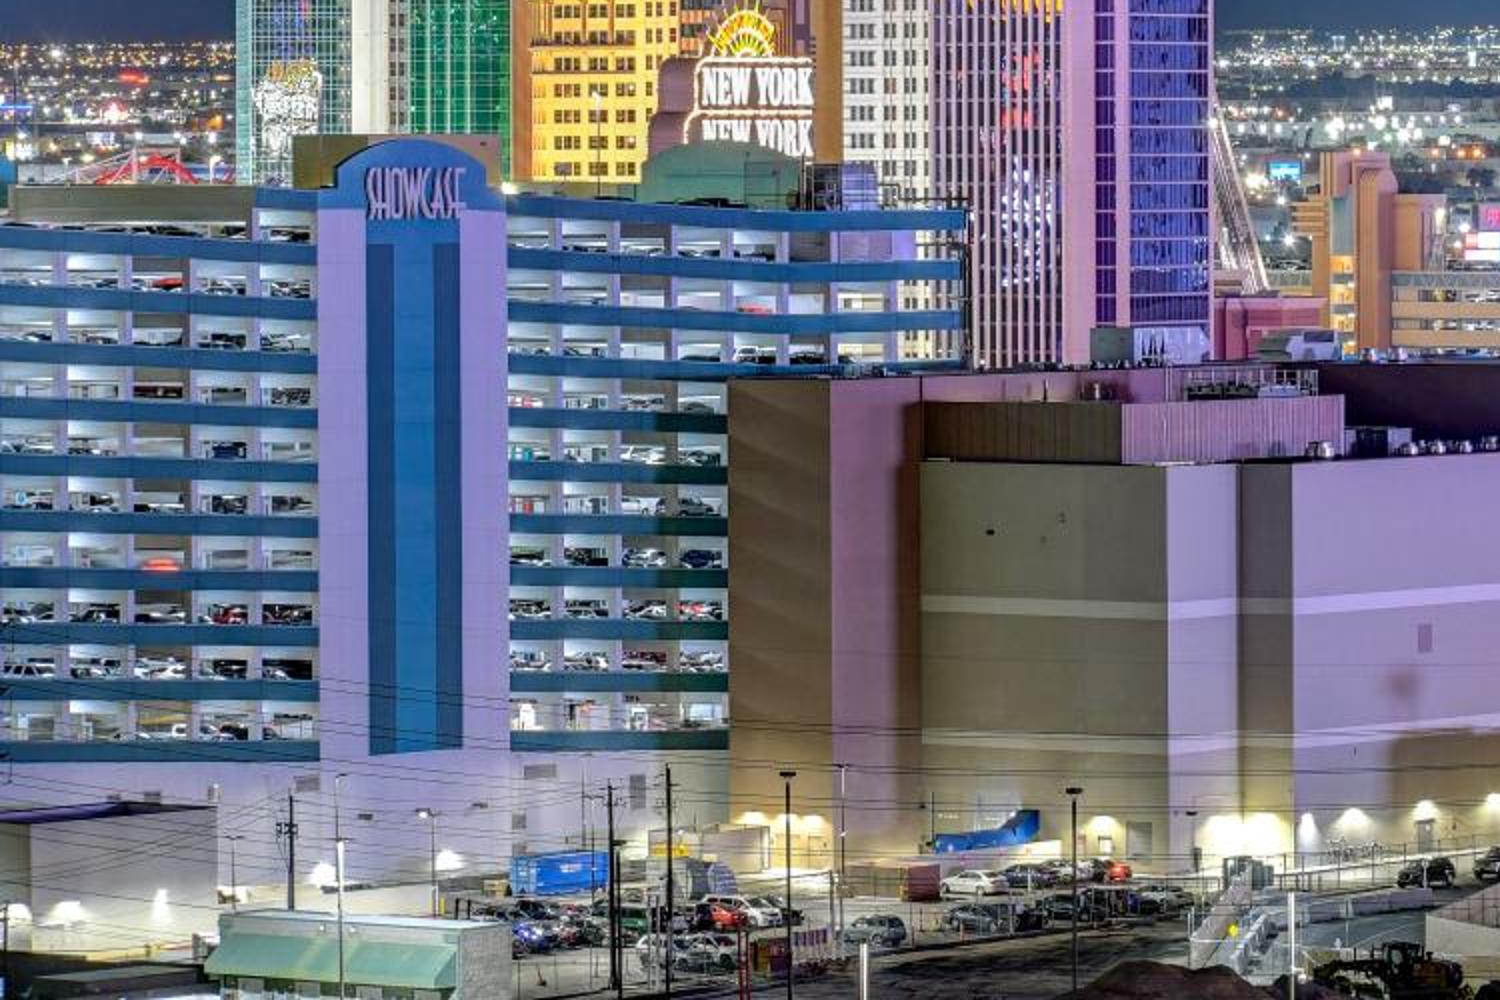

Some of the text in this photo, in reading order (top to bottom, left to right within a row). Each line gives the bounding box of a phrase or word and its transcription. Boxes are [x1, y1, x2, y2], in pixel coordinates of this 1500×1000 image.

[702, 65, 815, 107] NEW YORK
[755, 118, 815, 157] YORK
[366, 167, 466, 220] SHOWCASE
